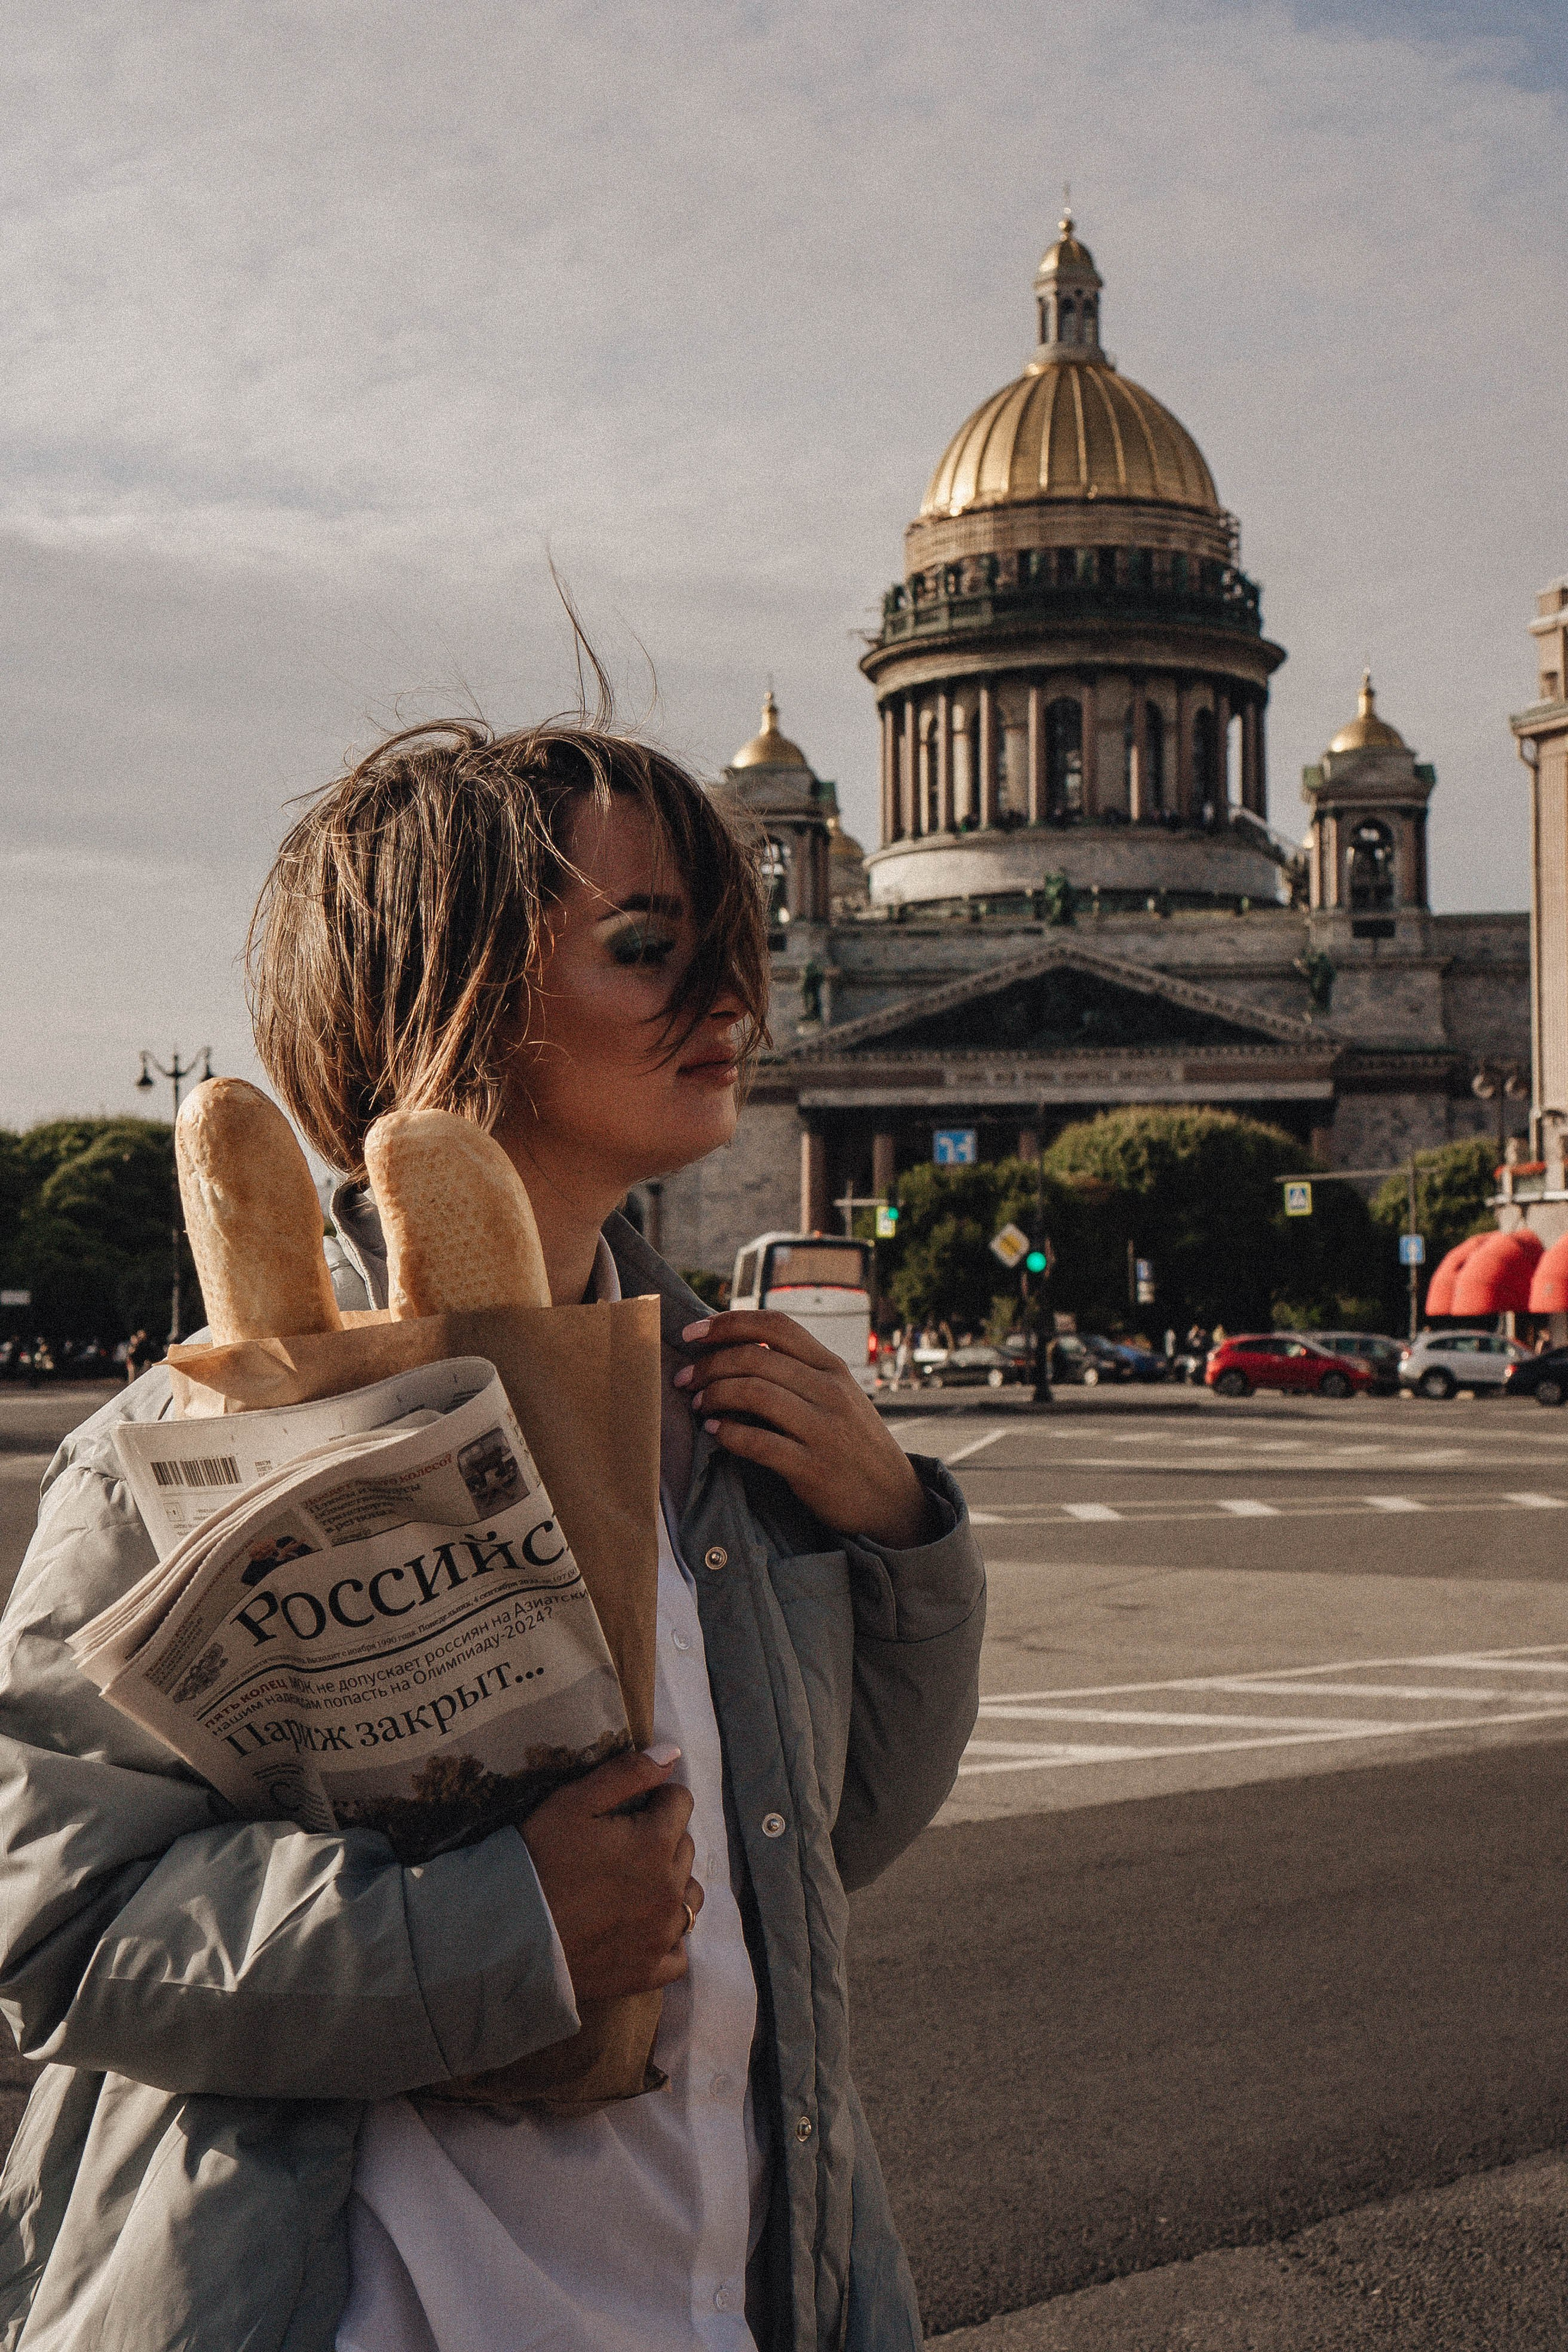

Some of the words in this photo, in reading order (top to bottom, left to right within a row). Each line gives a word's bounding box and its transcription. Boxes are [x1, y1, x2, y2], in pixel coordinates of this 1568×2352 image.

[399, 1454, 453, 1484] колесо?
[229, 1520, 566, 1647] РОССИЙС
[377, 1637, 397, 1648] 1990
[418, 1600, 473, 1633] Понедельник,
[205, 1702, 240, 1728] ПЯТЬ
[240, 1678, 288, 1704] КОЛЕЦ
[288, 1676, 315, 1694] МОК
[317, 1682, 336, 1694] не
[339, 1657, 421, 1693] допускает
[424, 1621, 489, 1665] россиян
[491, 1611, 511, 1627] на
[213, 1700, 263, 1736] нашим
[265, 1692, 322, 1710] надеждам
[323, 1687, 388, 1710] попасть
[390, 1680, 410, 1695] на
[413, 1605, 553, 1685] Олимпиаду-2024?
[221, 1718, 353, 1759] Париж
[356, 1661, 545, 1747] закрыт...
